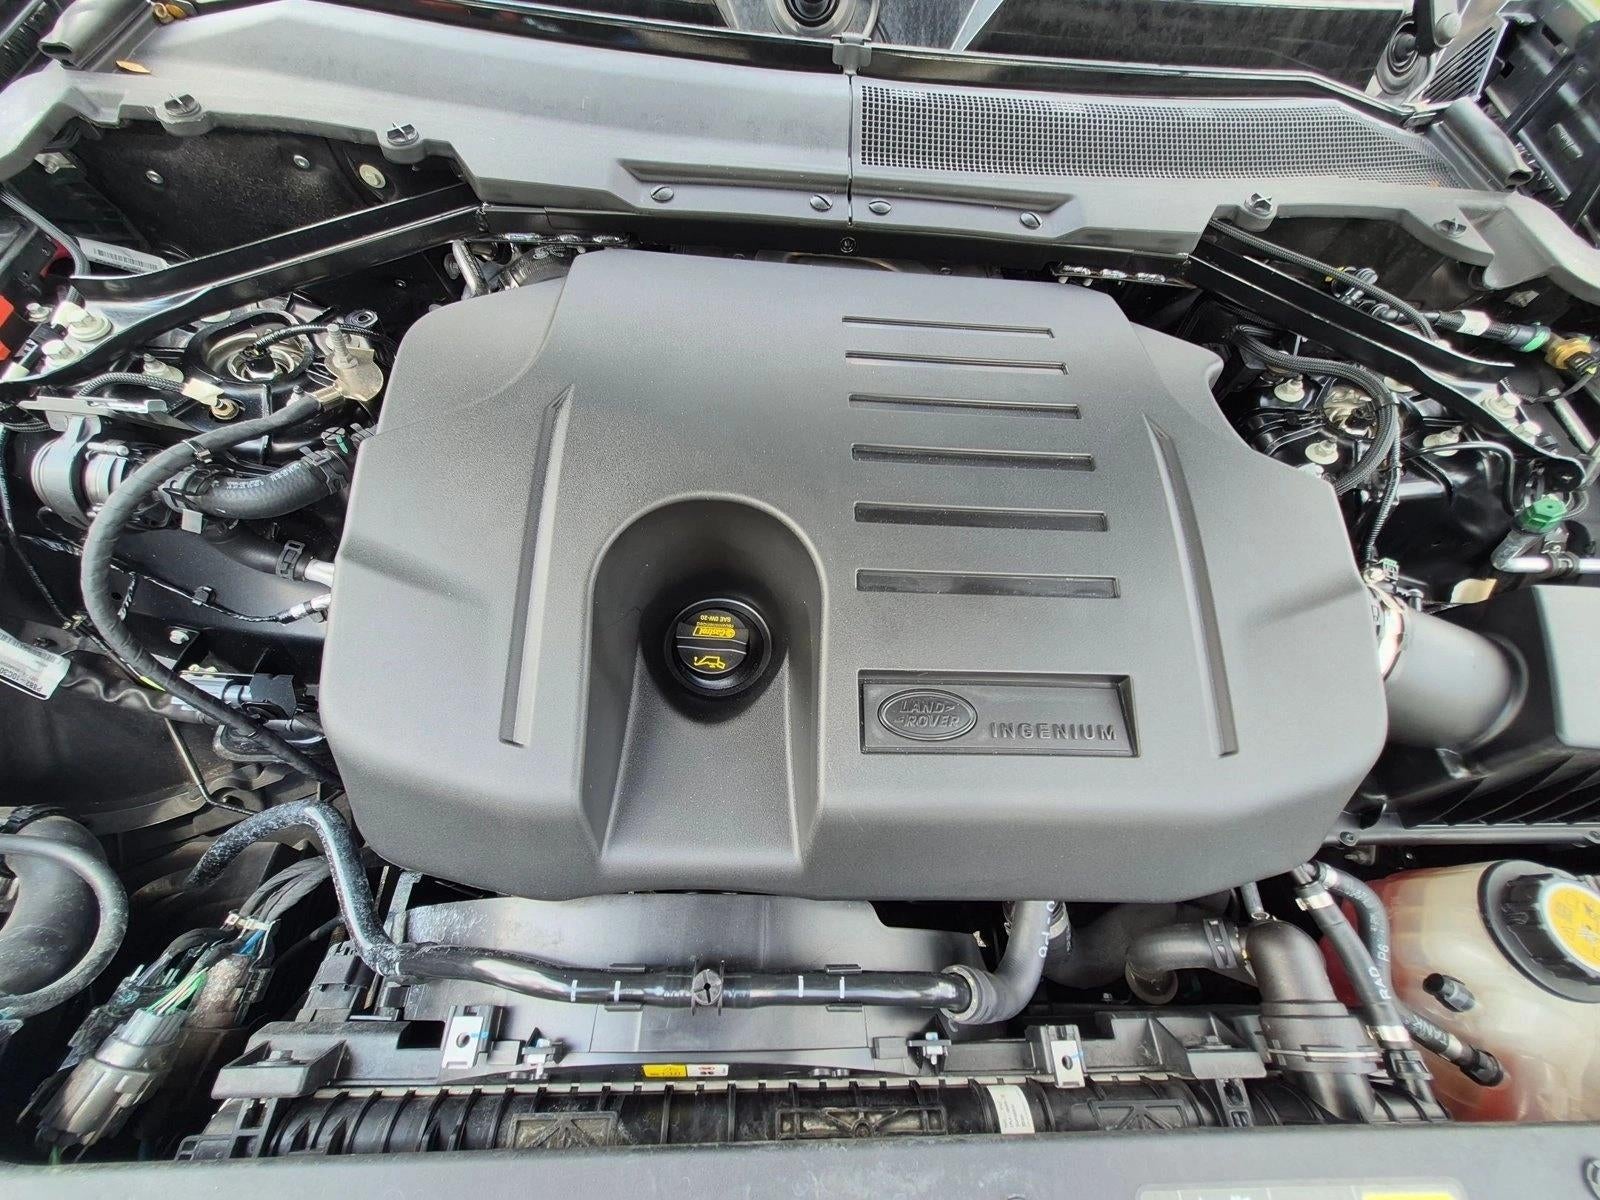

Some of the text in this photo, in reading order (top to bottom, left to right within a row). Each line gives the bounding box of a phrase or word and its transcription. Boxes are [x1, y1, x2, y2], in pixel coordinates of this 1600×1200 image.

[900, 699, 946, 714] LAND
[905, 714, 960, 728] ROVER
[989, 721, 1117, 741] INGENIUM
